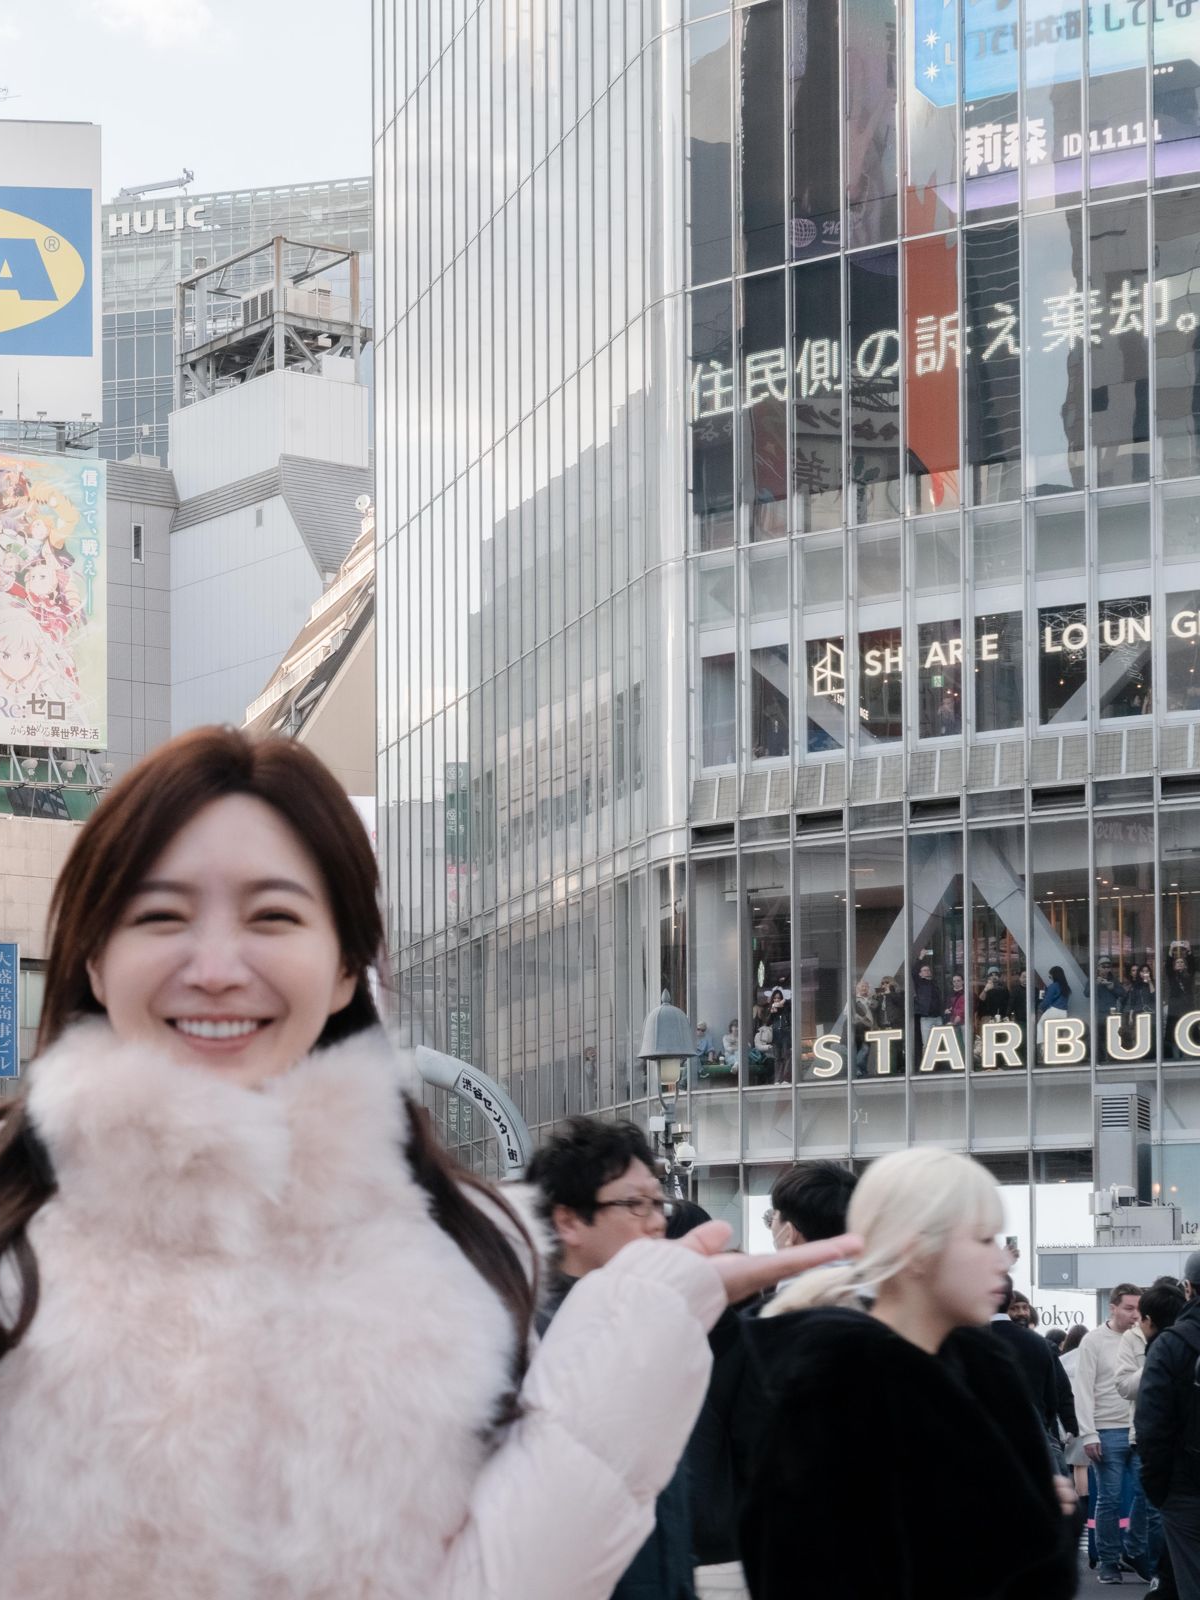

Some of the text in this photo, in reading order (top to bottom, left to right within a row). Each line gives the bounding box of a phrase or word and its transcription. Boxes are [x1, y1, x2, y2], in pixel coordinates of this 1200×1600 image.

[1062, 133, 1082, 157] ID
[109, 204, 206, 237] HULIC
[864, 610, 1200, 677] SHARE LOUNG
[10, 723, 100, 740] から始める異世界生活
[462, 1077, 518, 1163] 渋谷センター街
